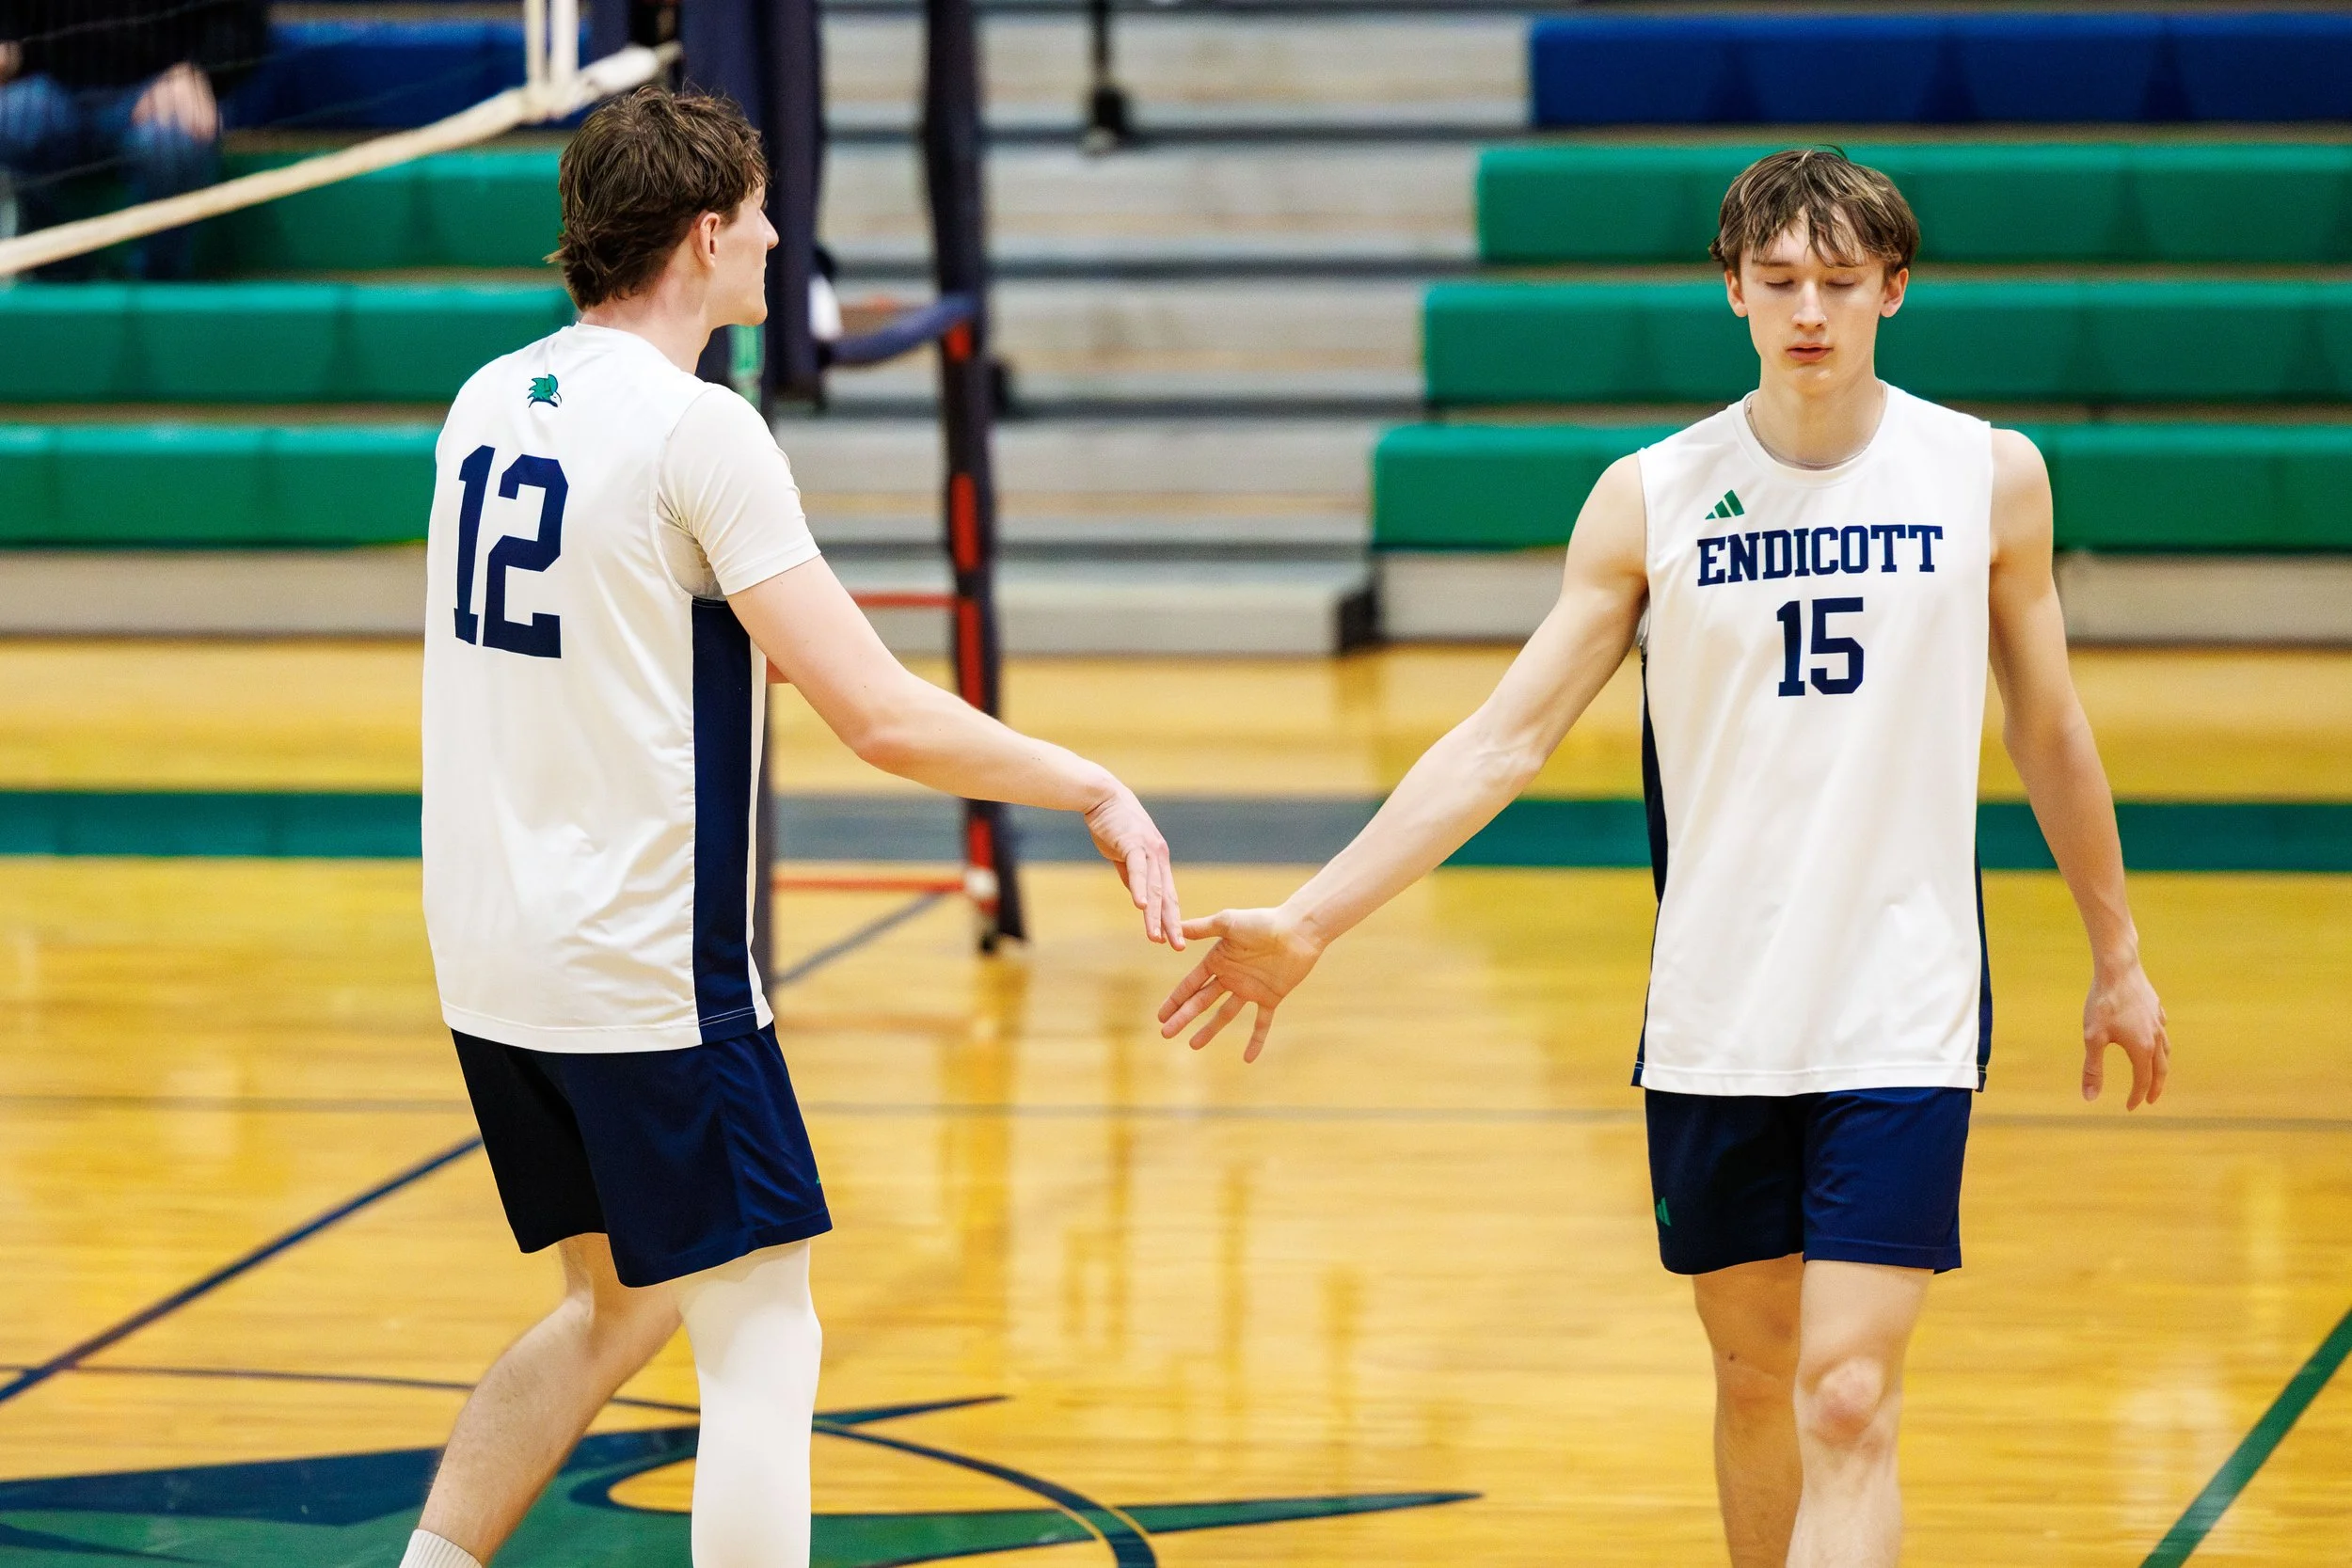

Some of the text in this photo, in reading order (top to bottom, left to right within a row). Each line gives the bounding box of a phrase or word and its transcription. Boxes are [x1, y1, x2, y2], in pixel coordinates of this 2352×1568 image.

[453, 445, 569, 658] 12
[1697, 524, 1944, 587] ENDICOTT
[1776, 596, 1865, 697] 15
